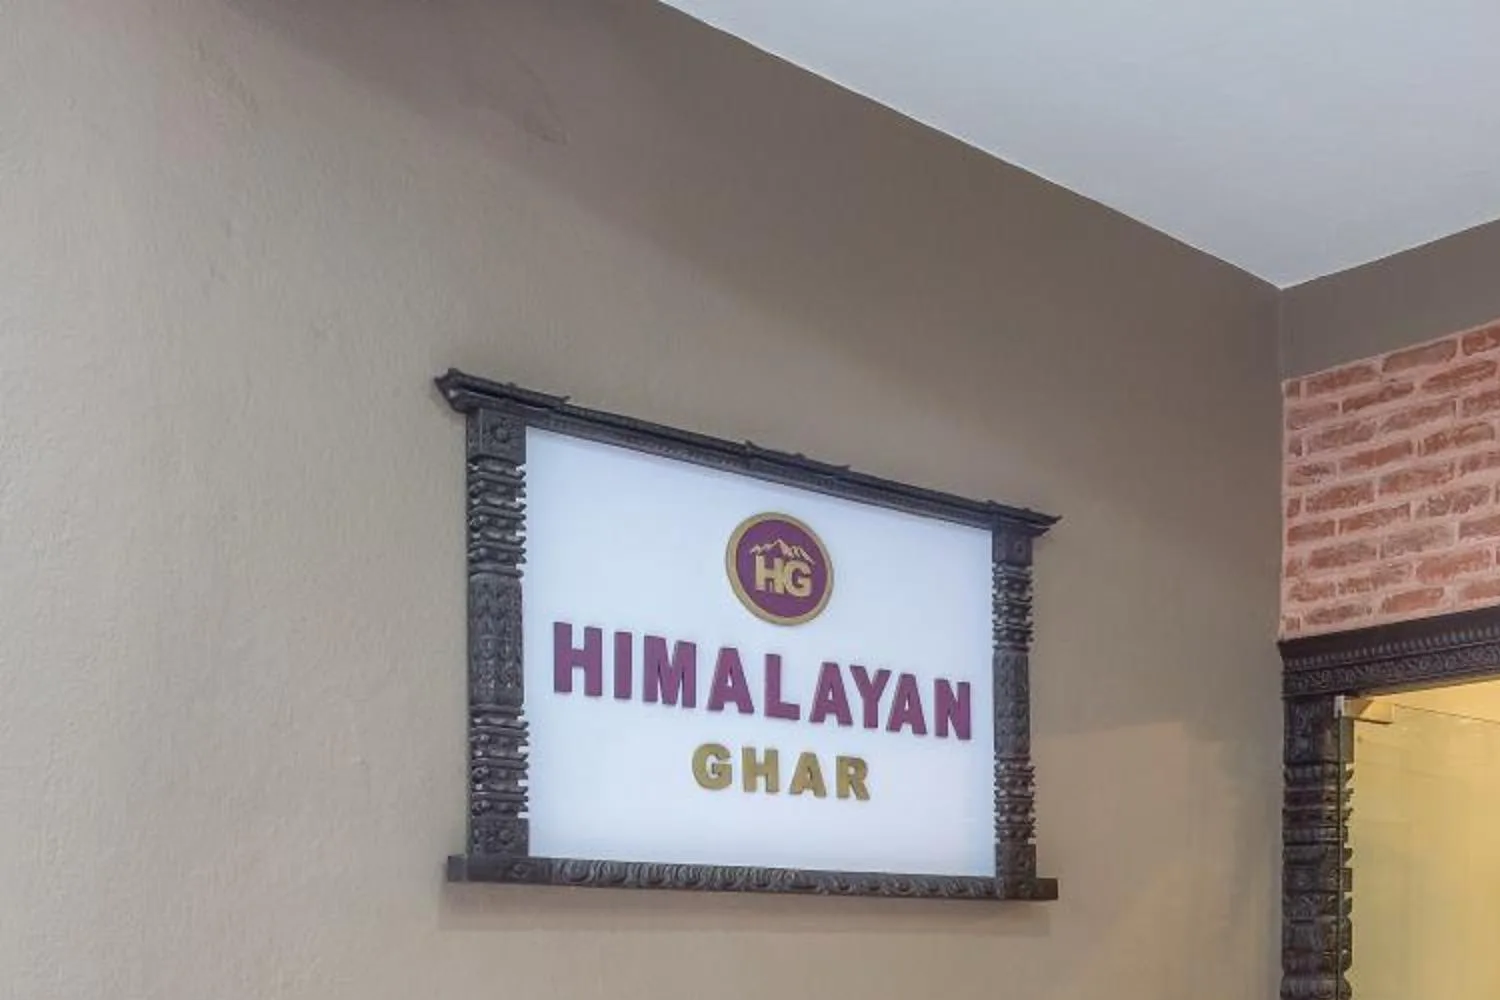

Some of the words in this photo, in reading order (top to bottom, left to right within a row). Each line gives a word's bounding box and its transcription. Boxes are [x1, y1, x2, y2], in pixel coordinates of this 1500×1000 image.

[755, 554, 812, 597] HG
[553, 621, 971, 740] HIMALAYAN
[691, 743, 870, 800] GHAR
